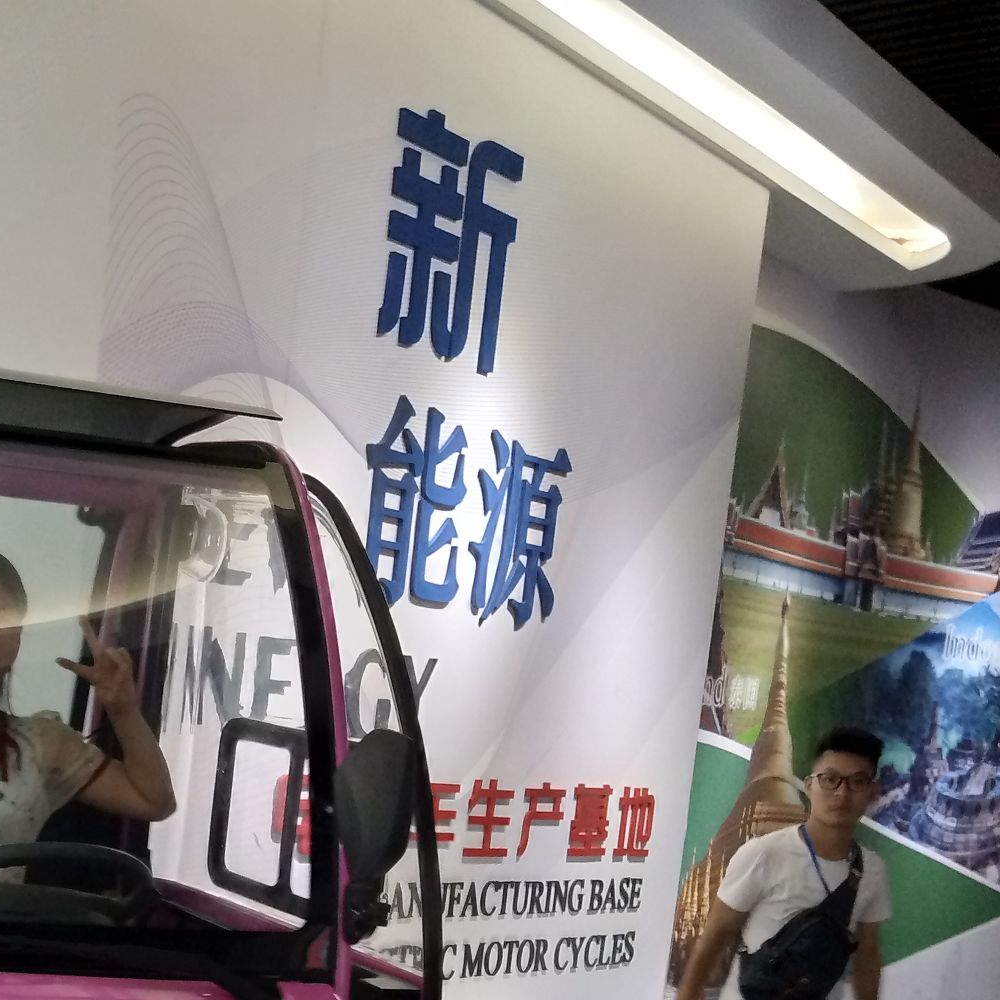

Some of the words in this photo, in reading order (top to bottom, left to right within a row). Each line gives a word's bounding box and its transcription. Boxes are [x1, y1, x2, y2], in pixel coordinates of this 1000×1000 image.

[377, 107, 525, 376] 新
[366, 394, 573, 632] 能源
[388, 879, 584, 919] ANFACTURING
[589, 878, 642, 912] BASE
[460, 939, 548, 978] MOTOR
[554, 930, 636, 970] CYCLES
